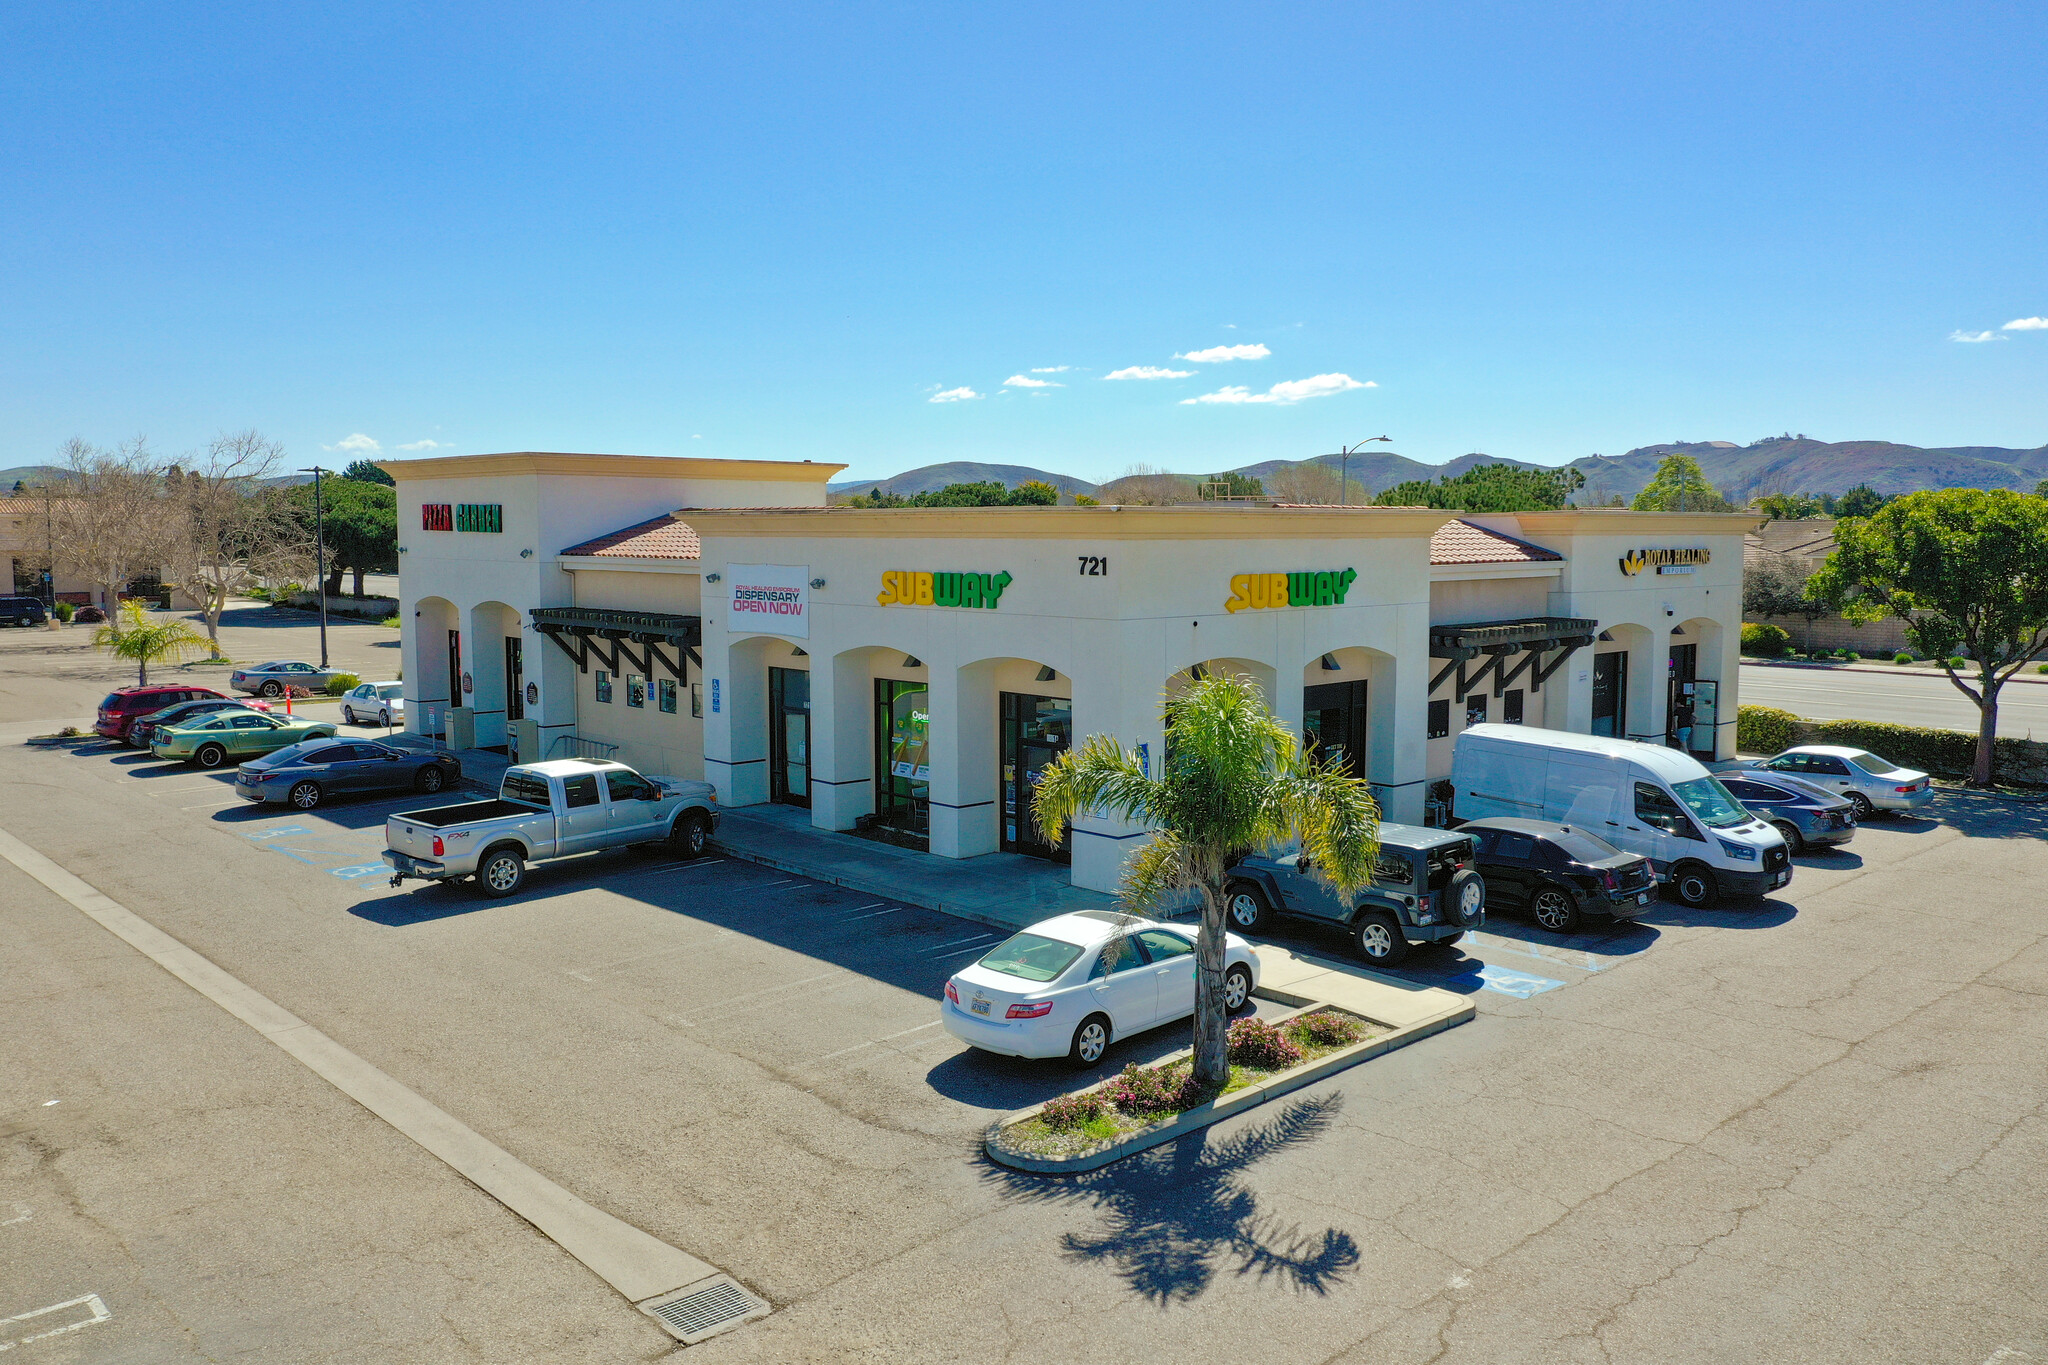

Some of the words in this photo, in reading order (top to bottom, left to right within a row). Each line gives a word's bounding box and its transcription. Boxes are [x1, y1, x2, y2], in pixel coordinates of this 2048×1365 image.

[456, 504, 502, 533] GARDEN
[1642, 549, 1673, 566] ROYAL
[1674, 548, 1711, 565] HEALING
[1078, 557, 1107, 576] 721
[1661, 567, 1696, 575] EMPORIUM
[735, 590, 800, 602] DISPENSARY
[876, 570, 1013, 609] SUBWAY
[1224, 567, 1357, 614] SUBWAY
[733, 600, 767, 613] OPEN
[769, 602, 803, 616] NOW
[447, 831, 471, 840] FX4
